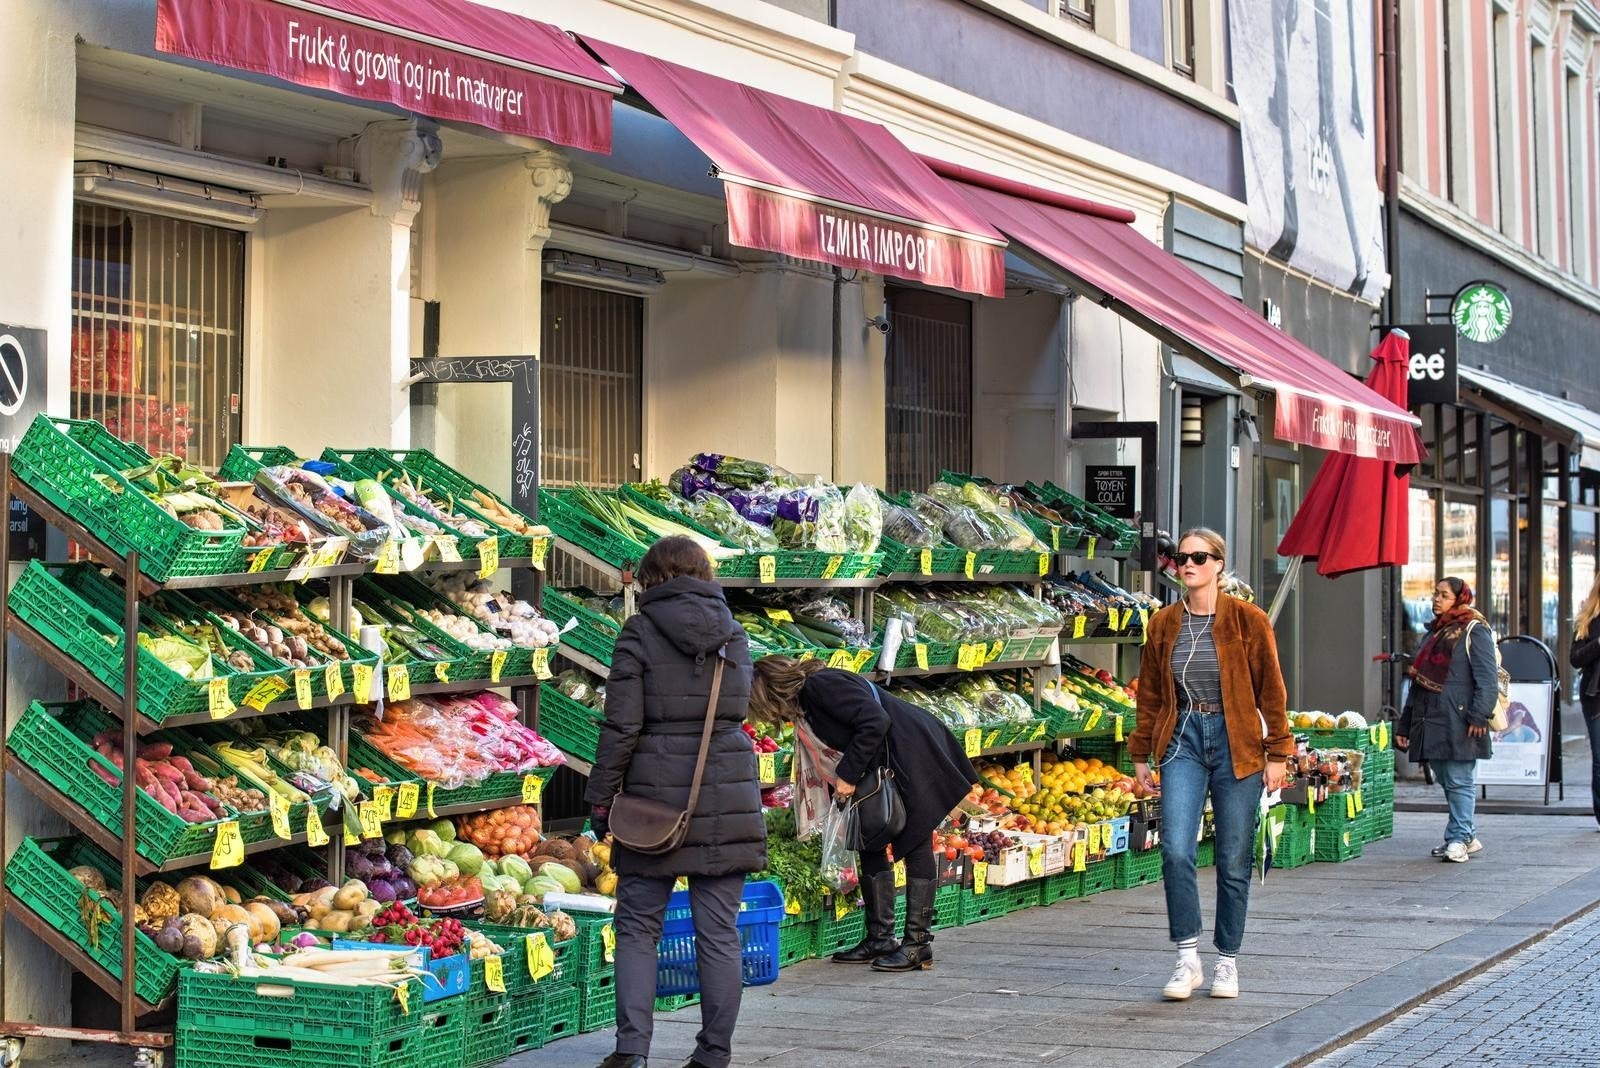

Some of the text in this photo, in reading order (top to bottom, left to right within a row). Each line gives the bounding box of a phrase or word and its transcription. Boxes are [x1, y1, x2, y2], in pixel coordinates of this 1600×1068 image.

[288, 21, 523, 116] Frukt & grønt og int. matvarer
[819, 214, 936, 275] IZMIR IMPORT
[1407, 352, 1445, 381] ee
